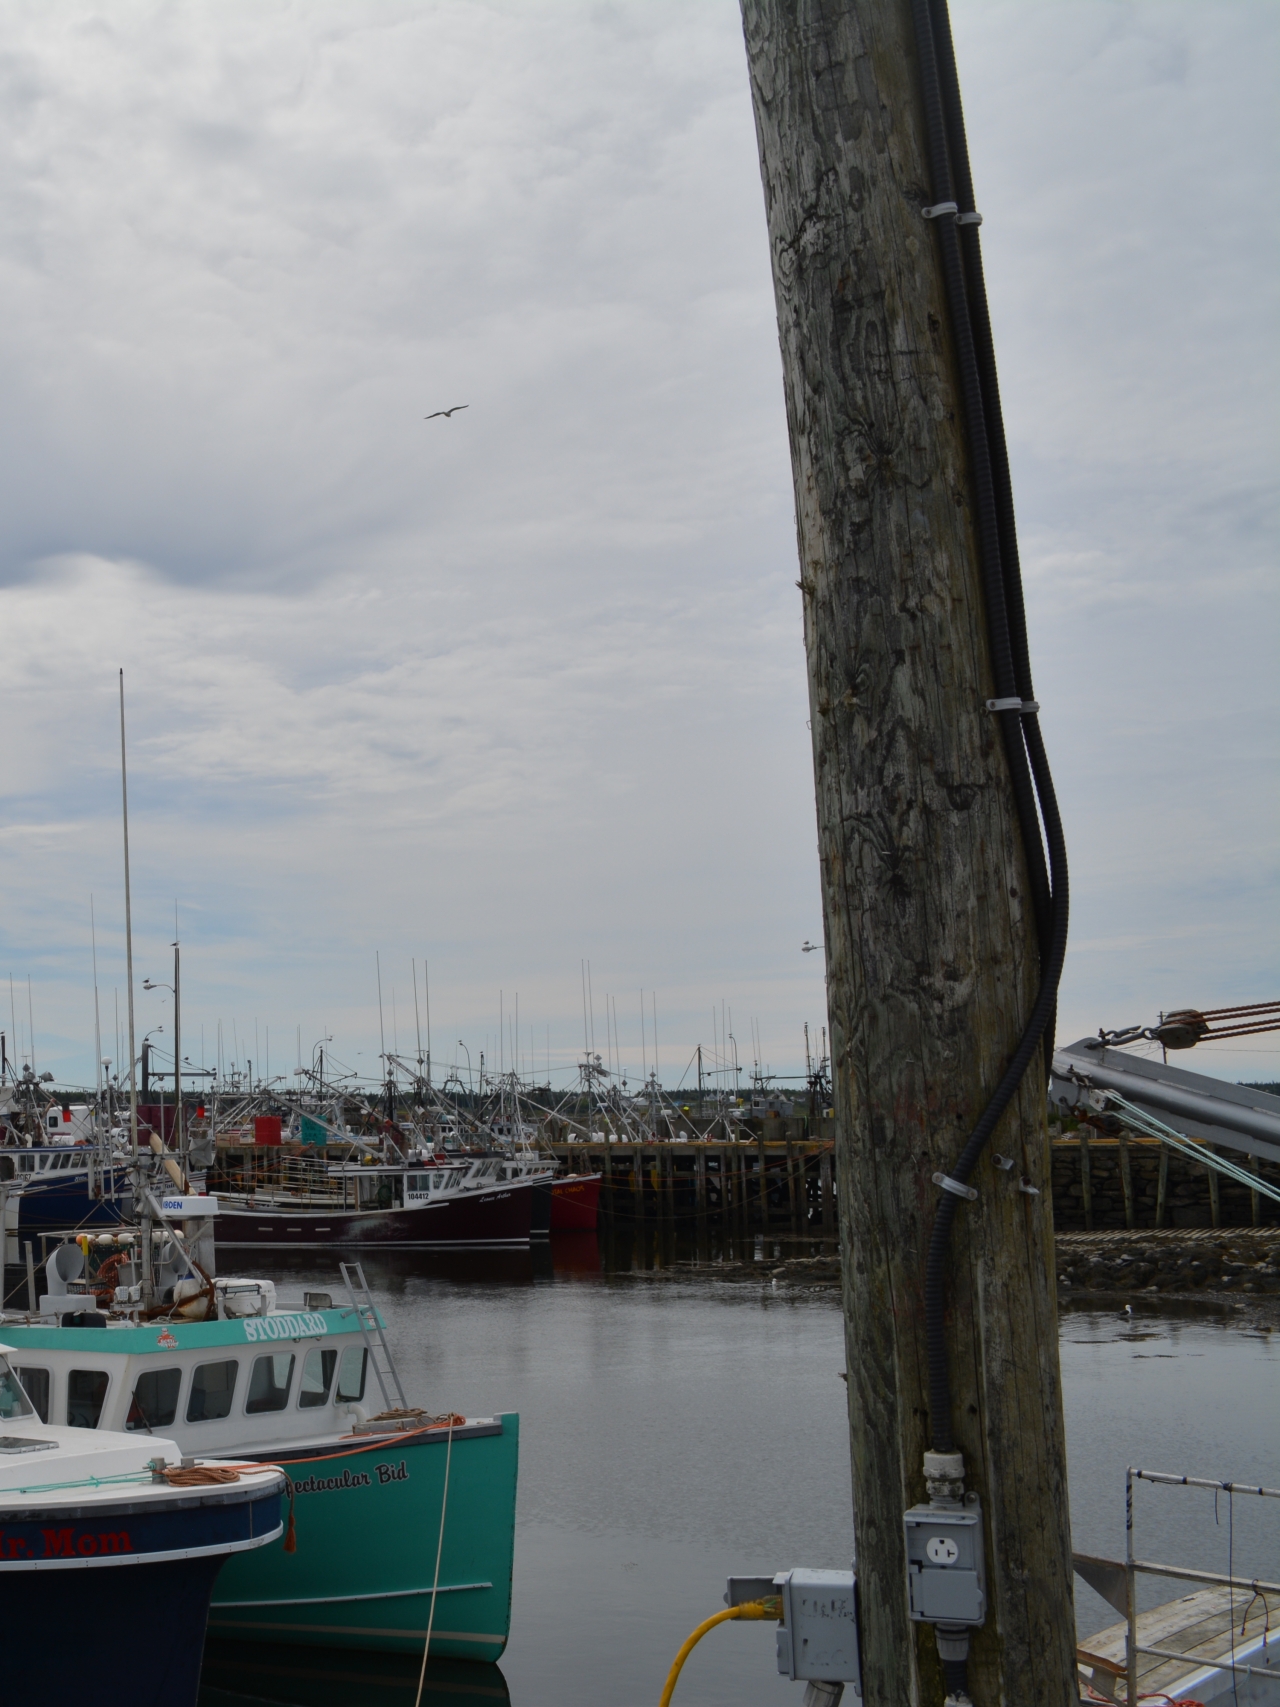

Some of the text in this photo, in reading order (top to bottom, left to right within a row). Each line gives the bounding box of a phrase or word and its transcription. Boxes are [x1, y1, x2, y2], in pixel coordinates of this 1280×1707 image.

[407, 1192, 429, 1200] 104412
[243, 1312, 328, 1342] STODDARD
[374, 1460, 409, 1484] Bid
[40, 1527, 134, 1558] Mom
